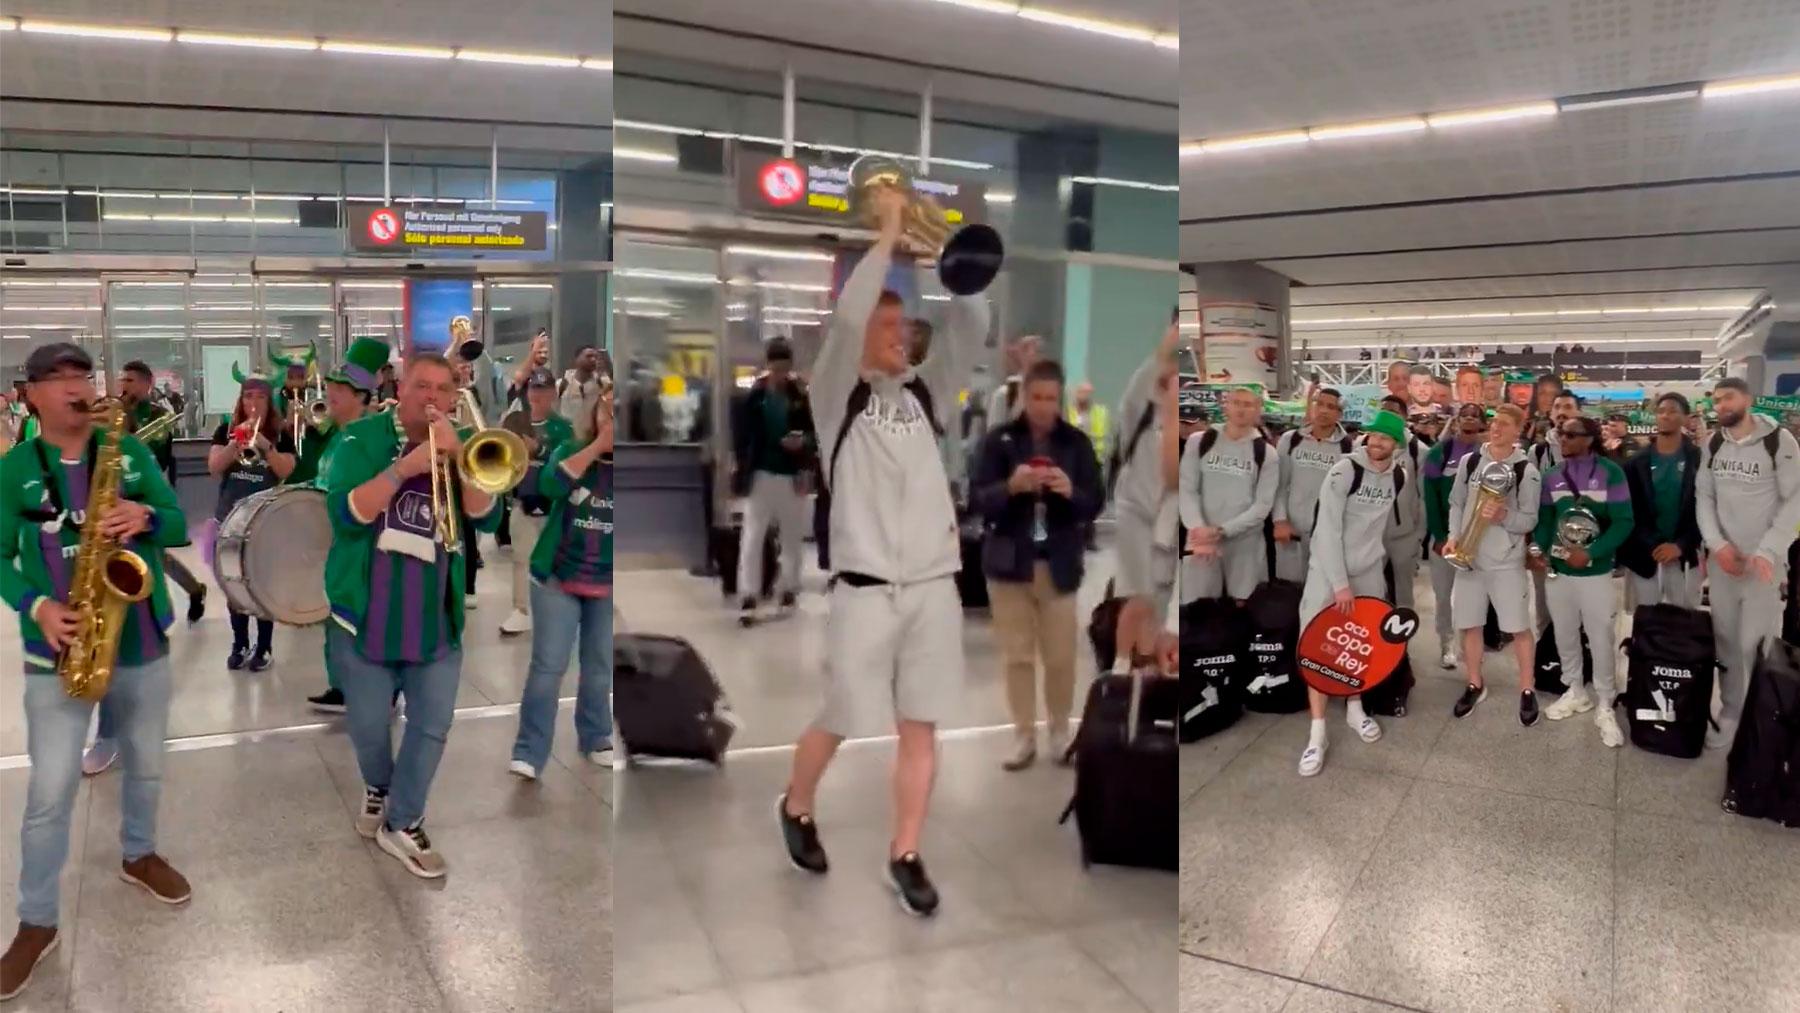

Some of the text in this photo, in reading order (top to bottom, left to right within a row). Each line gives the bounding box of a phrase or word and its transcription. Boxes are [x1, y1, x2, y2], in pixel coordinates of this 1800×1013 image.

[1627, 425, 1659, 434] UNIC
[1344, 621, 1370, 639] acb
[1248, 642, 1284, 652] Joma
[1326, 626, 1374, 657] Copa
[1193, 654, 1236, 667] Joma
[1334, 651, 1369, 676] Rey
[1300, 658, 1321, 671] Gran
[1319, 666, 1350, 683] Canaria
[1651, 665, 1693, 679] Joma
